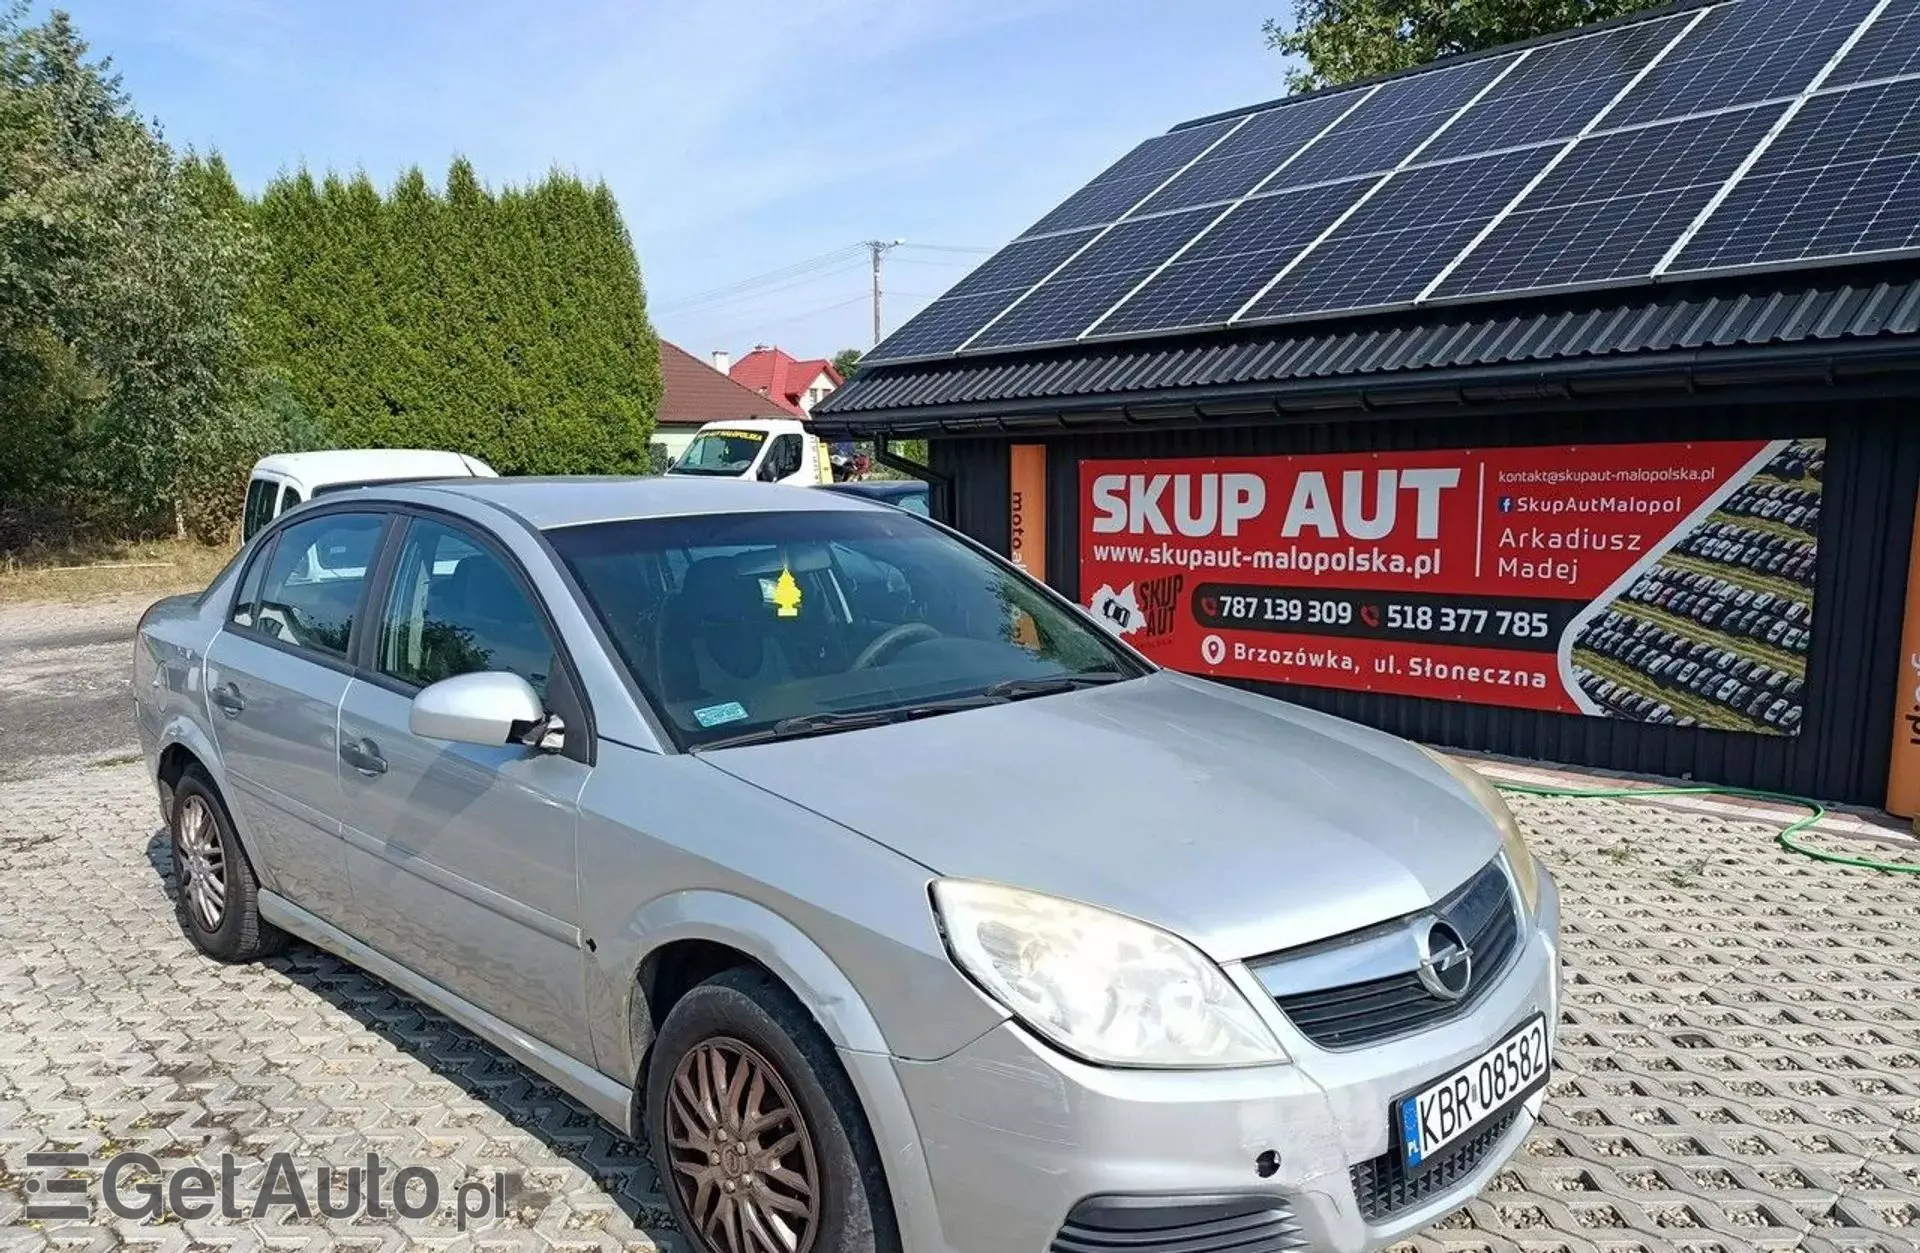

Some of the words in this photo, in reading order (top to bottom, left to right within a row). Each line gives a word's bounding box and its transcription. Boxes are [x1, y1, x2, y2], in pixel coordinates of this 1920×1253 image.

[1498, 467, 1715, 484] kontakt@skupaut-malopolska.pl
[1092, 473, 1266, 537] SKUP
[1280, 468, 1461, 540] AUT
[1517, 497, 1681, 515] SkupAutMalopol
[1499, 527, 1641, 551] Arkadiusz
[1093, 543, 1441, 579] www.skupaut-malopolska.pl
[1498, 557, 1578, 584] Madej
[1140, 574, 1184, 611] SKUP
[1147, 605, 1176, 637] AUT
[1219, 596, 1258, 618] 787
[1263, 598, 1302, 621] 139
[1307, 601, 1352, 624] 309
[1387, 604, 1433, 630] 518
[1439, 607, 1488, 634] 377
[1495, 610, 1549, 638] 785
[1234, 643, 1360, 674] Brzozówka,
[1374, 654, 1402, 675] ul.
[1408, 657, 1547, 688] Słoneczna
[1420, 1075, 1473, 1152] KBR
[1478, 1026, 1544, 1110] 08582
